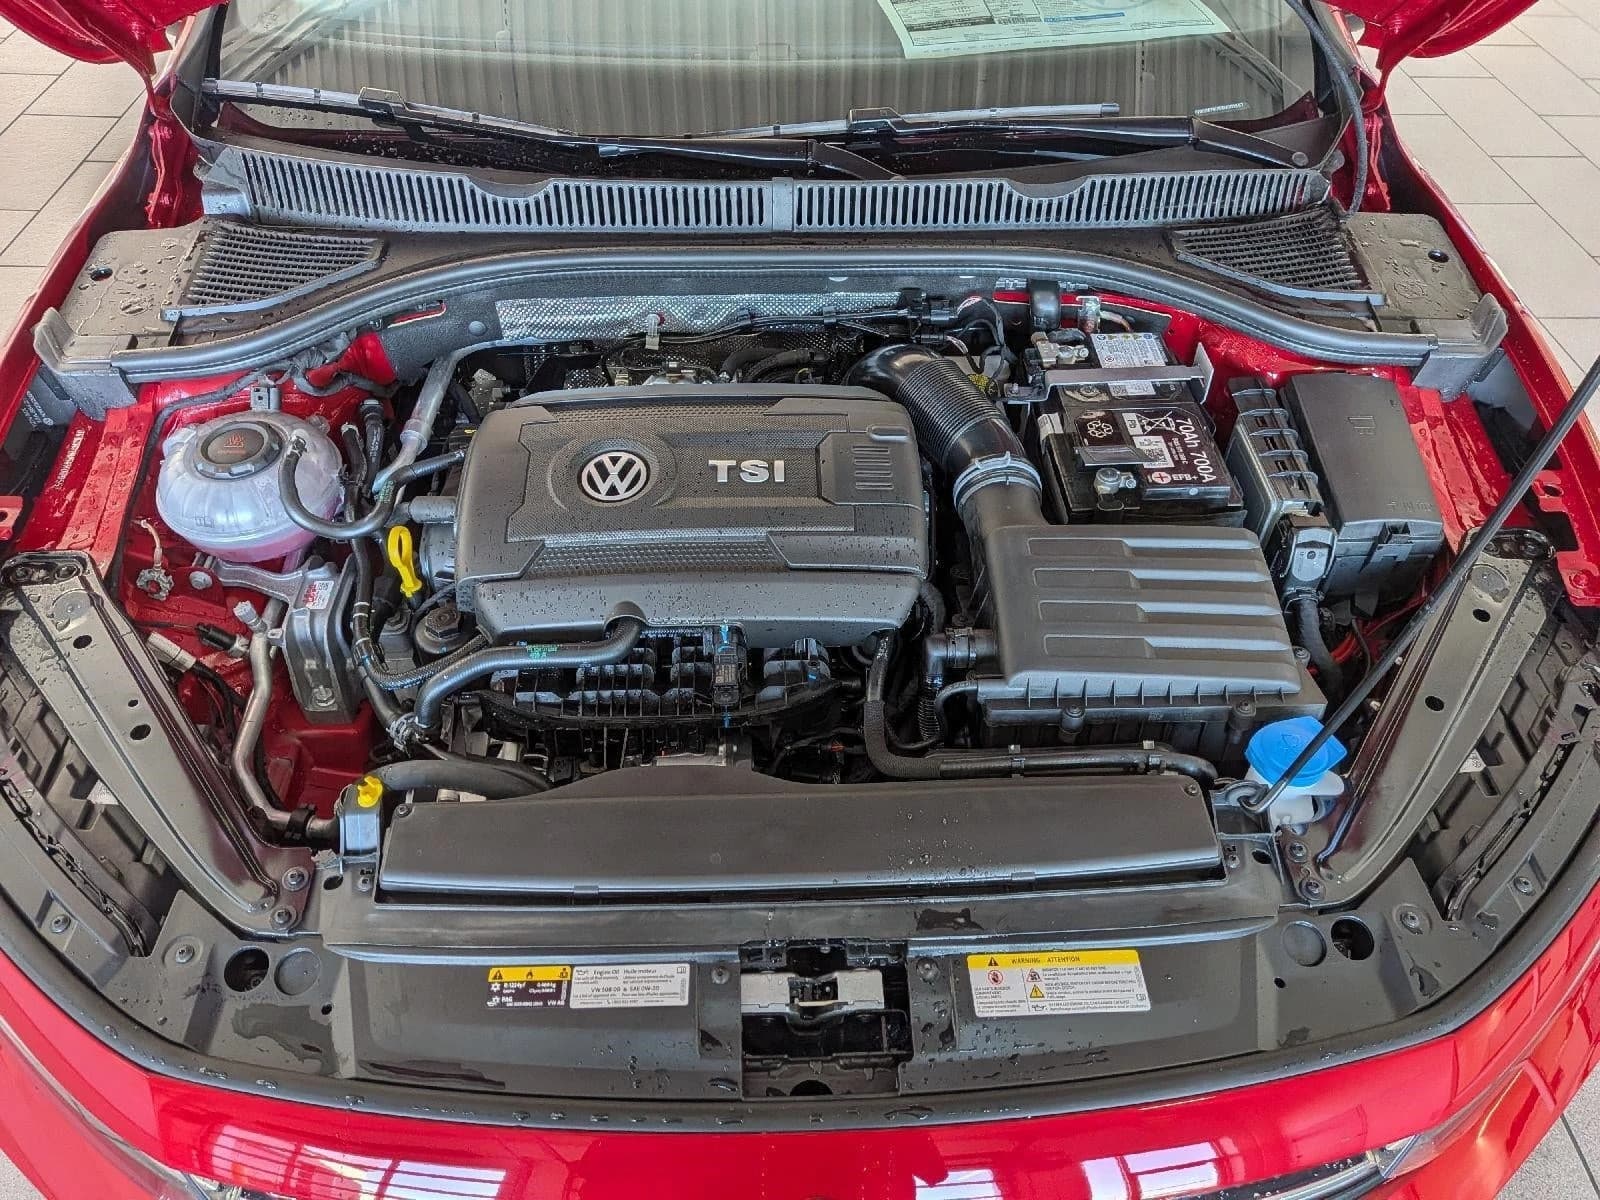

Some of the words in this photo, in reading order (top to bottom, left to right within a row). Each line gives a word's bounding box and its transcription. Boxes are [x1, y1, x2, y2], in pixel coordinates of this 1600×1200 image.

[1176, 418, 1200, 448] 70Ah
[1190, 451, 1217, 483] 700A
[708, 459, 785, 483] TSI
[1011, 957, 1041, 965] WARNING
